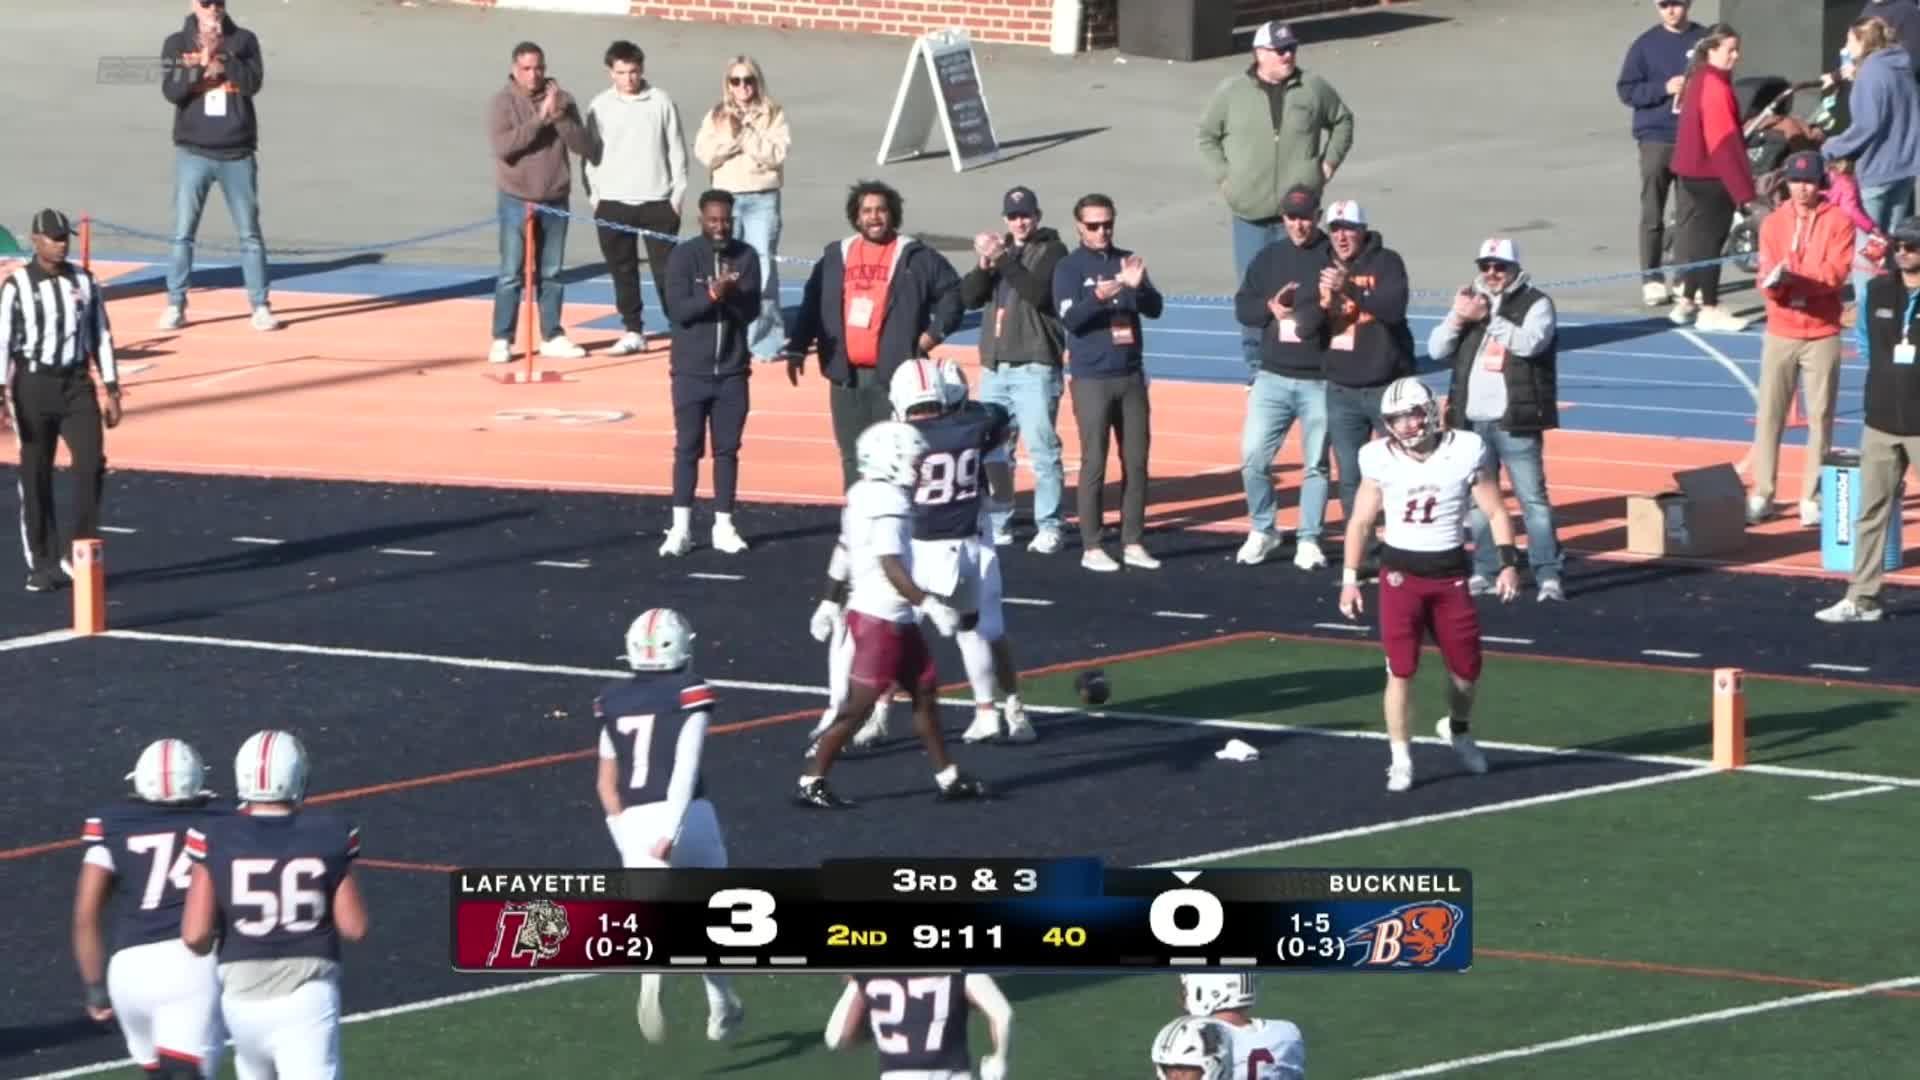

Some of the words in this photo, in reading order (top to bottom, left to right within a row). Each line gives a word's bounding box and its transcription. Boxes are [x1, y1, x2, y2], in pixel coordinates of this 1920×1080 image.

[913, 448, 979, 505] 89
[1401, 496, 1439, 524] 11
[616, 714, 657, 789] 7
[230, 856, 327, 937] 56
[865, 975, 952, 1054] 27
